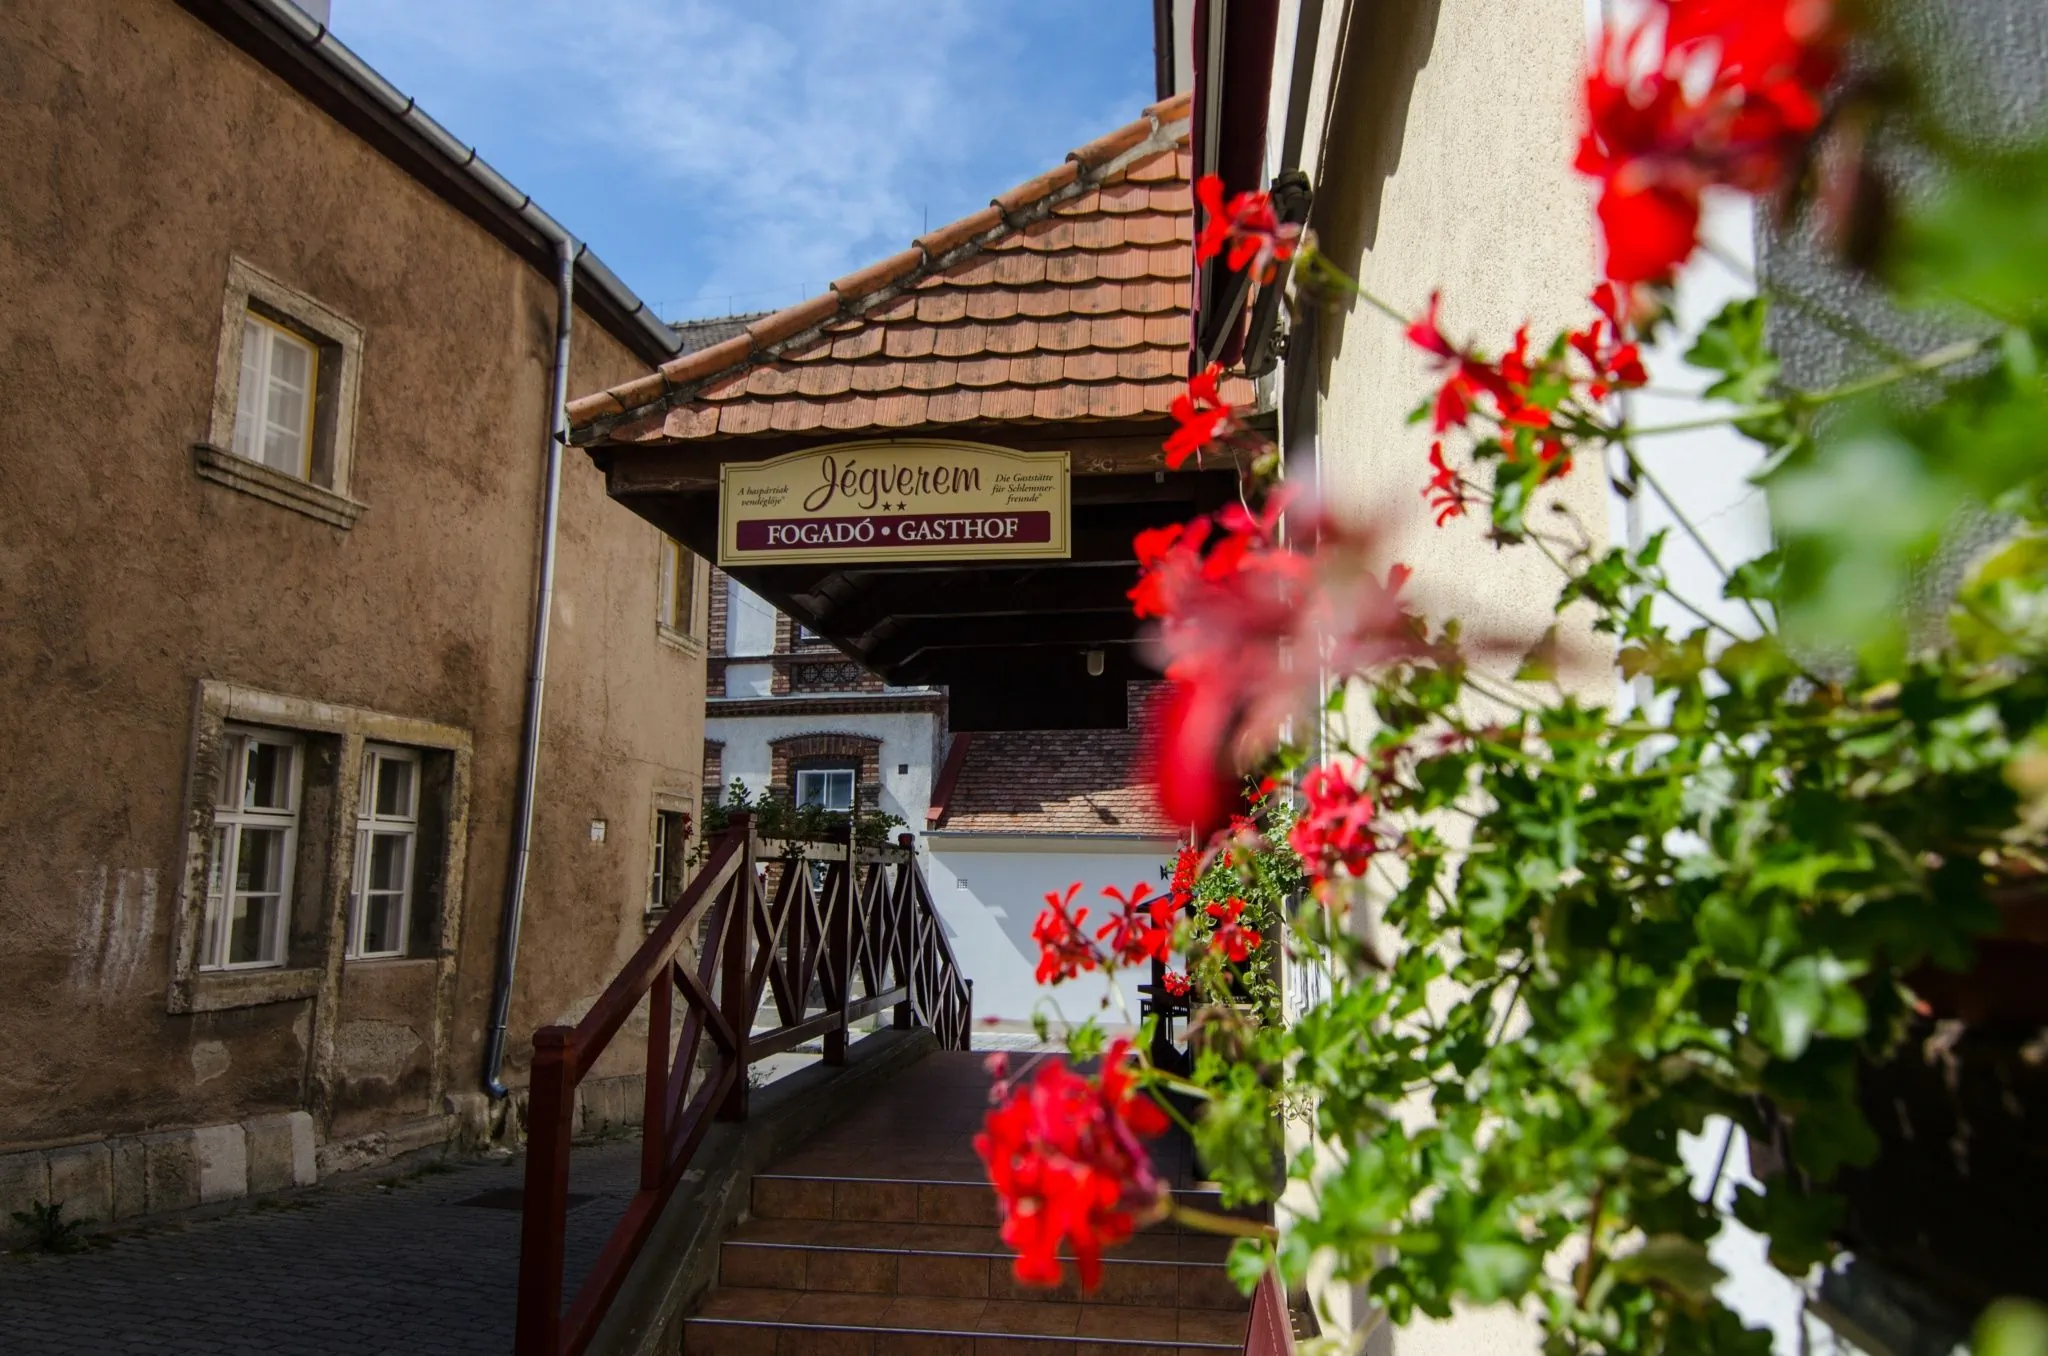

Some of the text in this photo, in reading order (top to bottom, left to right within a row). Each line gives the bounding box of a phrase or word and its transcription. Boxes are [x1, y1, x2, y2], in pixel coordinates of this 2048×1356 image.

[995, 472, 1054, 482] Die Gaststätte
[803, 455, 982, 512] Jégverem
[736, 486, 745, 496] A
[991, 484, 1005, 496] für
[767, 517, 1019, 545] FOGADÓ GASTHOF
